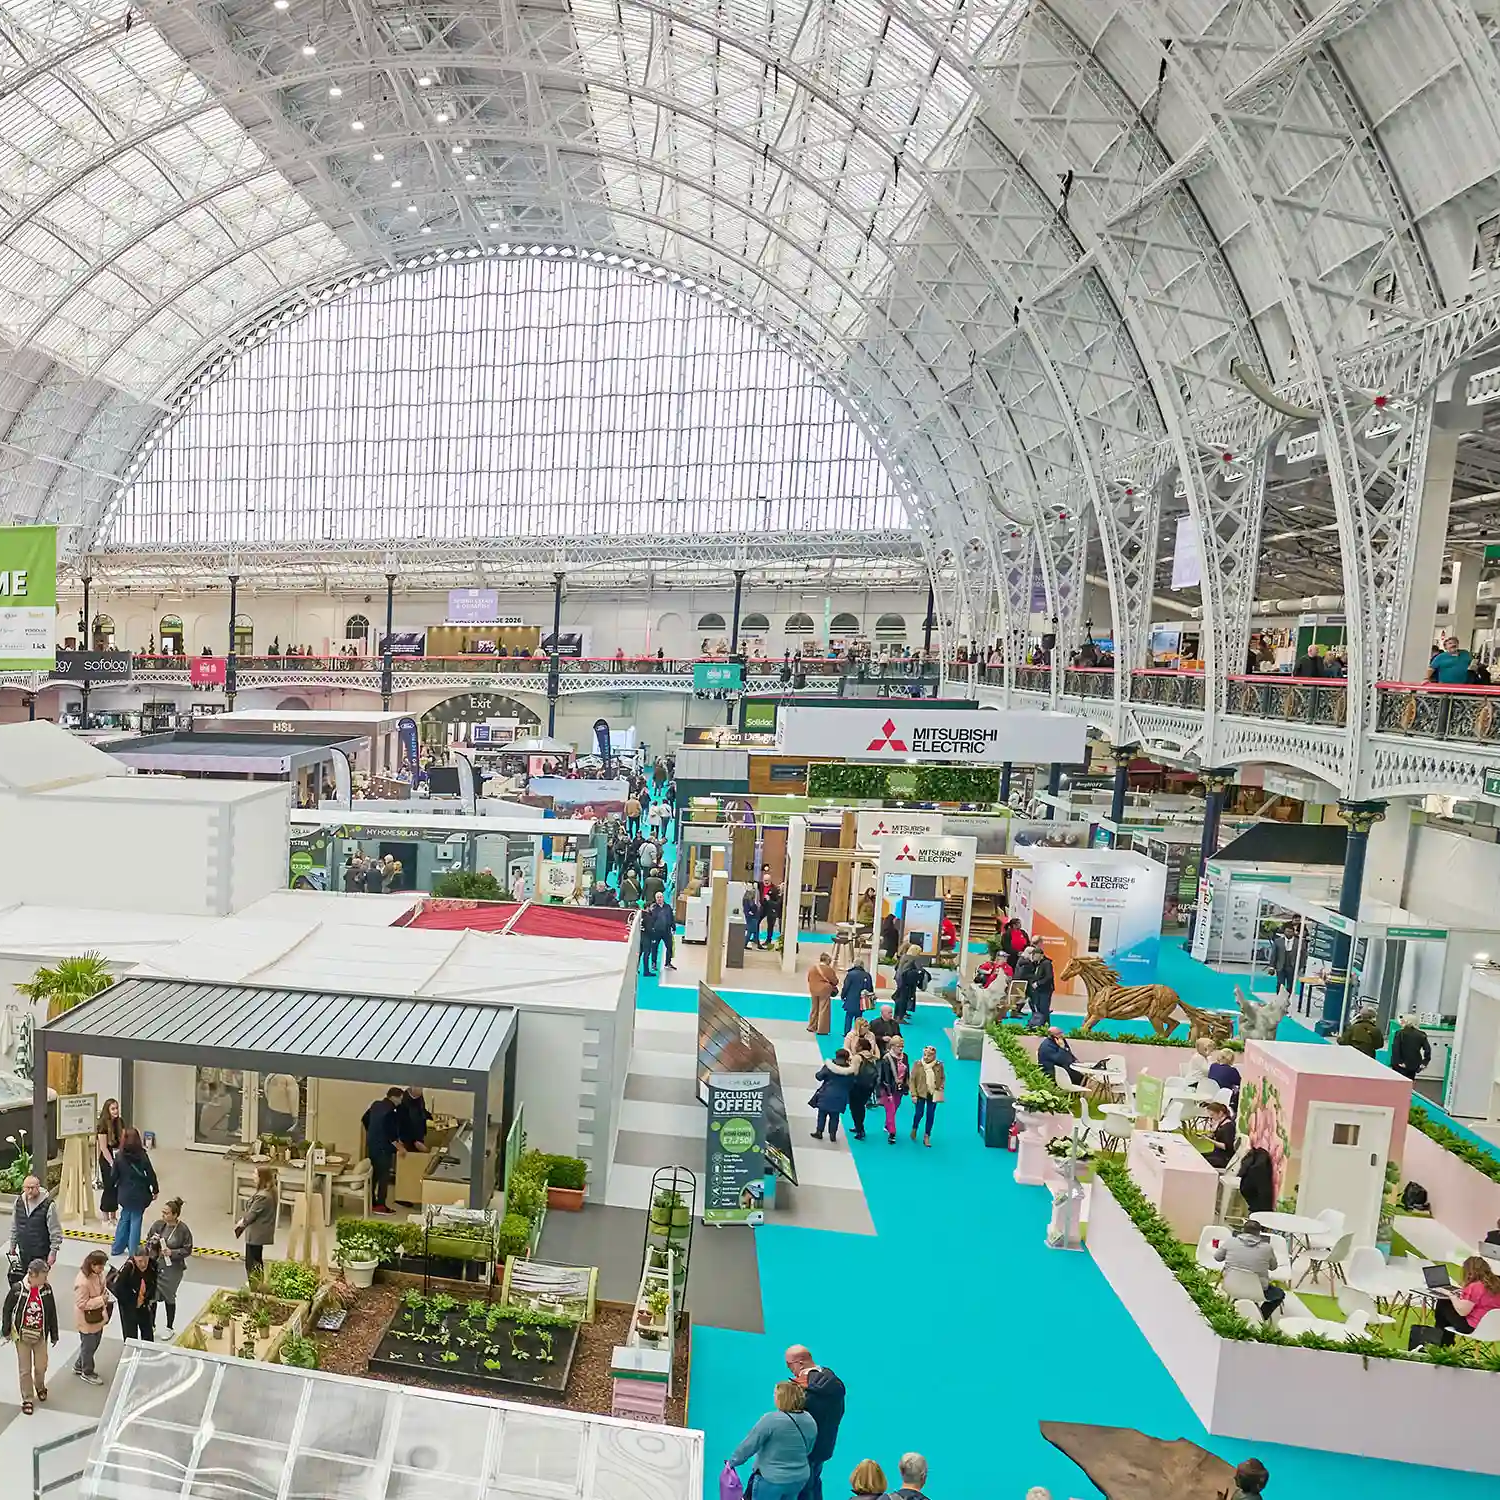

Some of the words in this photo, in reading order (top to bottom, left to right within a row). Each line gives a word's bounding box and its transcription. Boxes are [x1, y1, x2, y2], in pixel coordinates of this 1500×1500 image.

[83, 659, 128, 673] sofology
[470, 698, 491, 709] Exit
[272, 722, 295, 733] HSL
[913, 728, 998, 741] MITSUBISHI
[912, 741, 985, 753] ELECTRIC
[918, 849, 963, 857] MITSUBISHI
[1091, 875, 1136, 884] MITSUBISHI
[1090, 882, 1129, 890] ELECTRIC
[714, 1091, 764, 1100] EXCLUSIVE
[714, 1099, 763, 1112] OFFER
